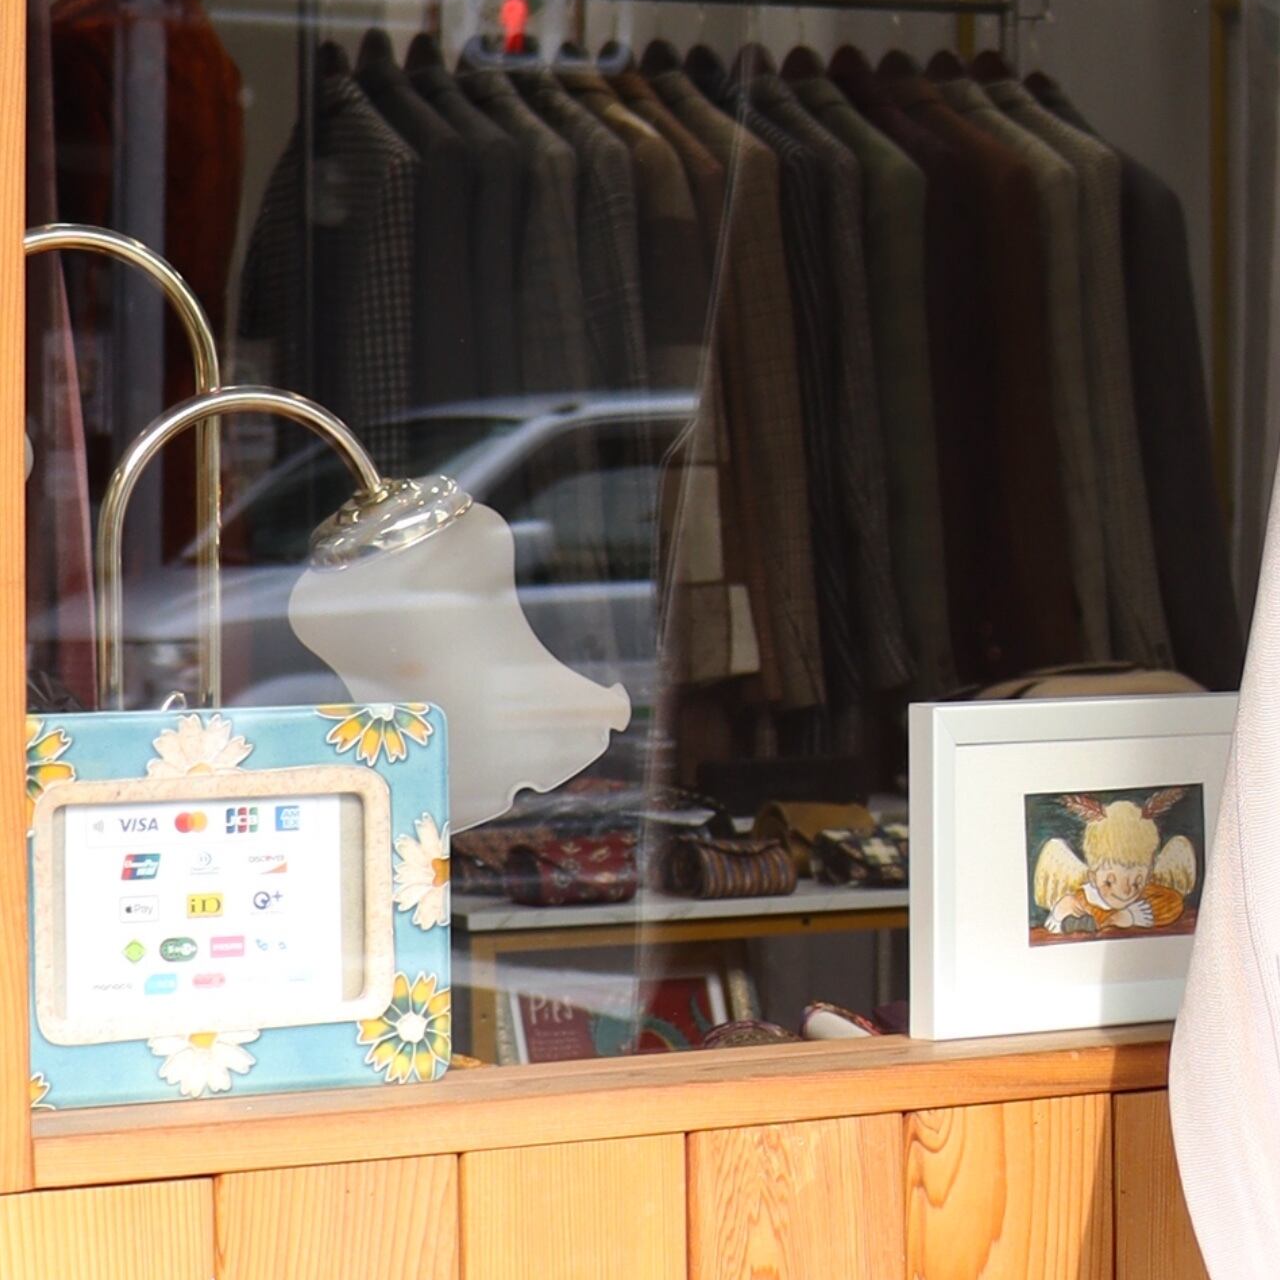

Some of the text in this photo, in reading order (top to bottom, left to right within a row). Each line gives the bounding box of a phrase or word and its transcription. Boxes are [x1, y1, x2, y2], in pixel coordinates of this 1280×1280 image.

[120, 817, 159, 832] VISA
[133, 904, 153, 915] Pay
[190, 897, 221, 914] iD
